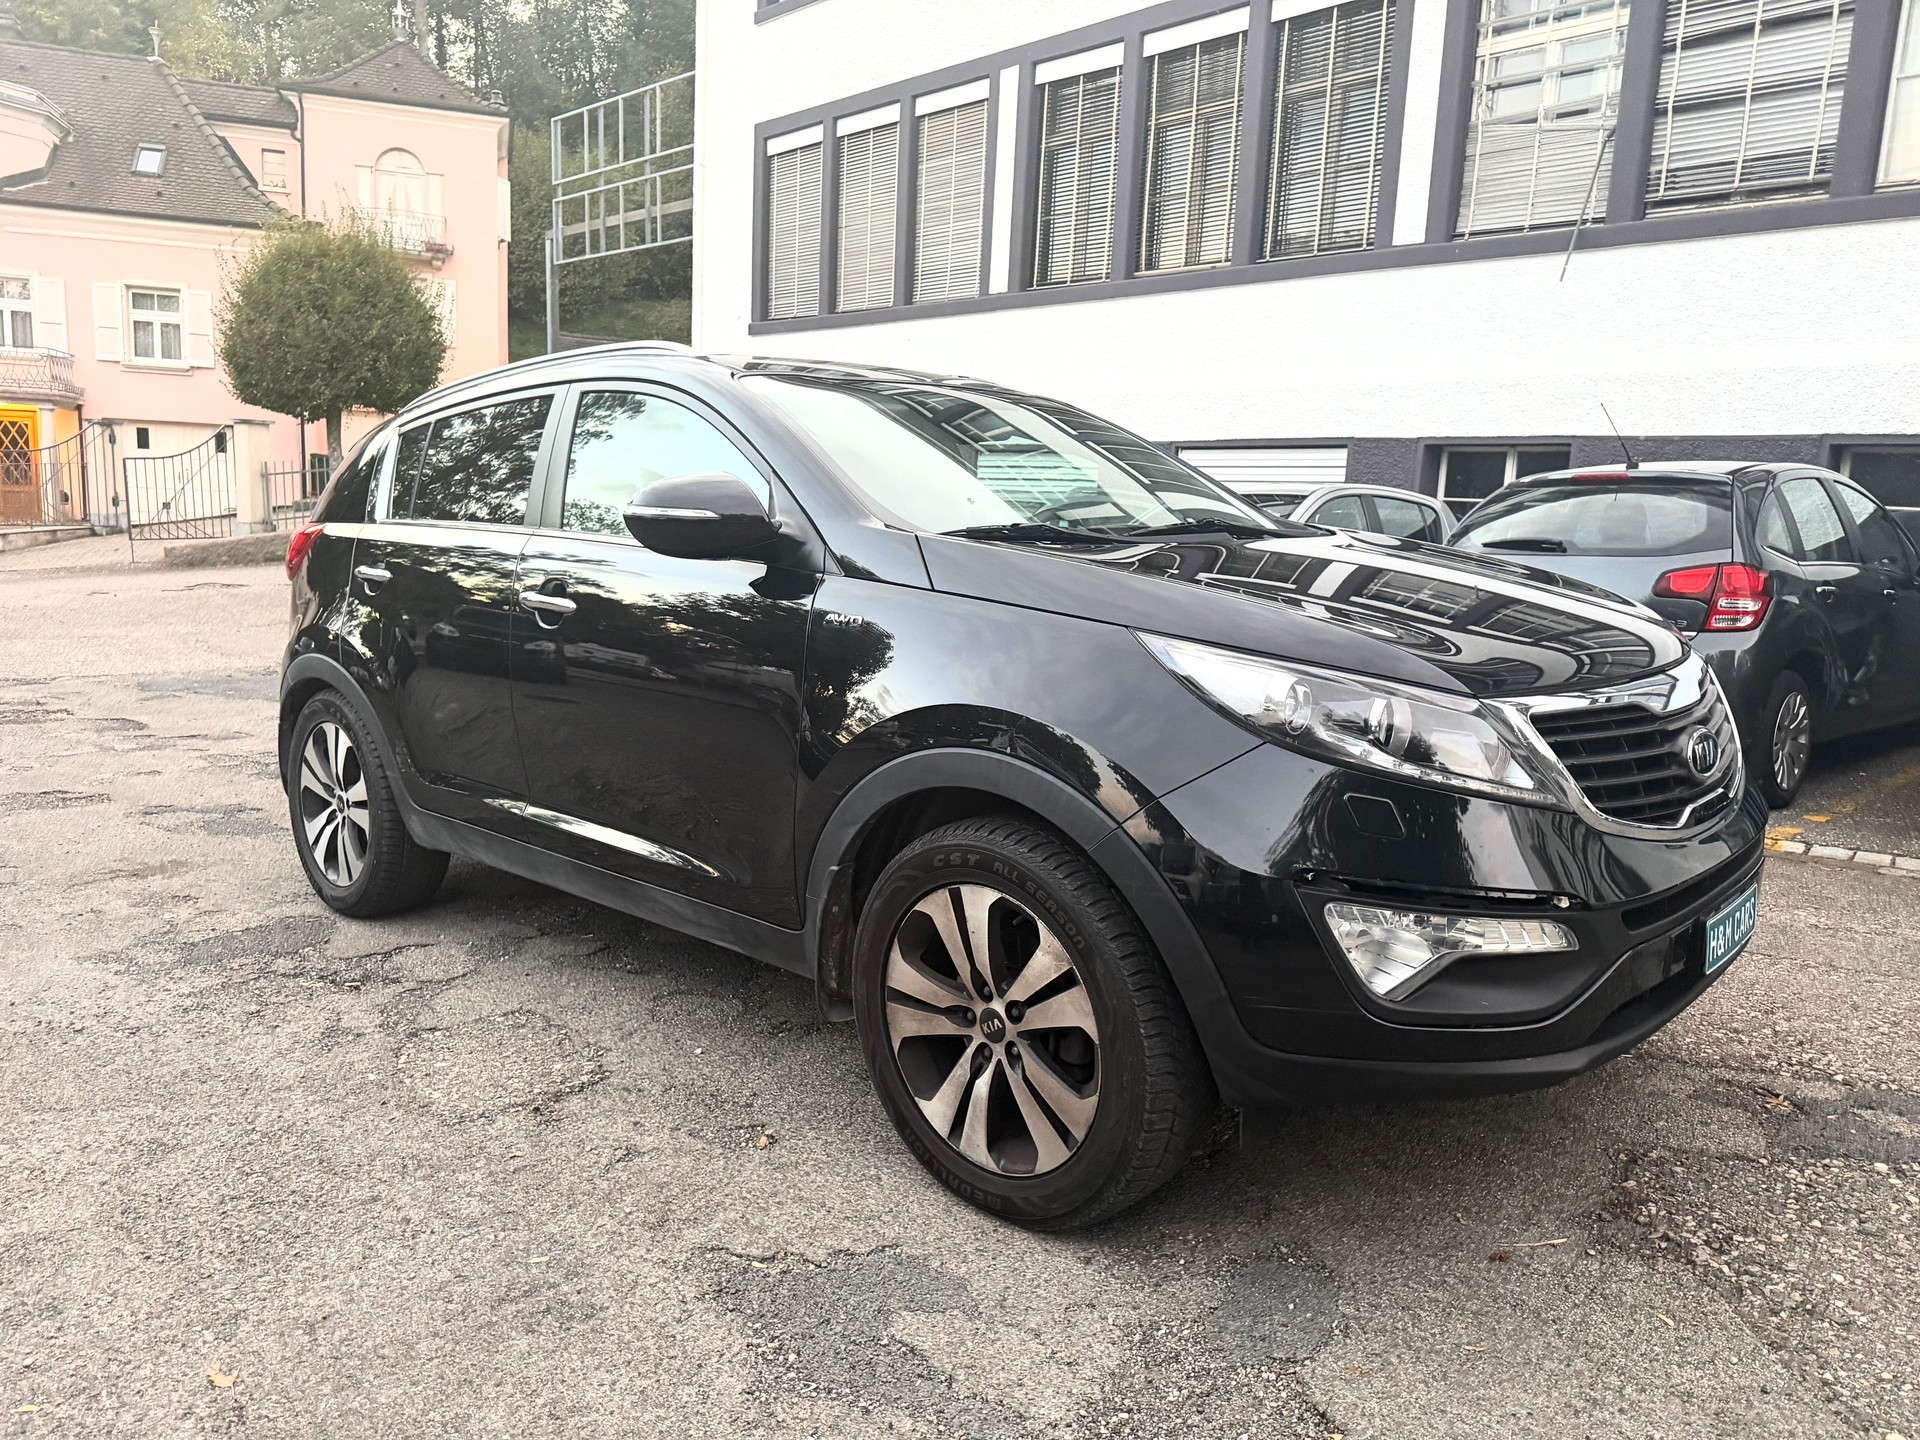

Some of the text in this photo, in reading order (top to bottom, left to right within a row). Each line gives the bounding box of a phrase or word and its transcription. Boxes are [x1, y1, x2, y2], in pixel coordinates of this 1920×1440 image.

[824, 613, 863, 626] AWD
[933, 852, 1085, 950] CST ALL SEASON
[1709, 897, 1755, 962] H&M CARS
[982, 1018, 1003, 1034] KIA
